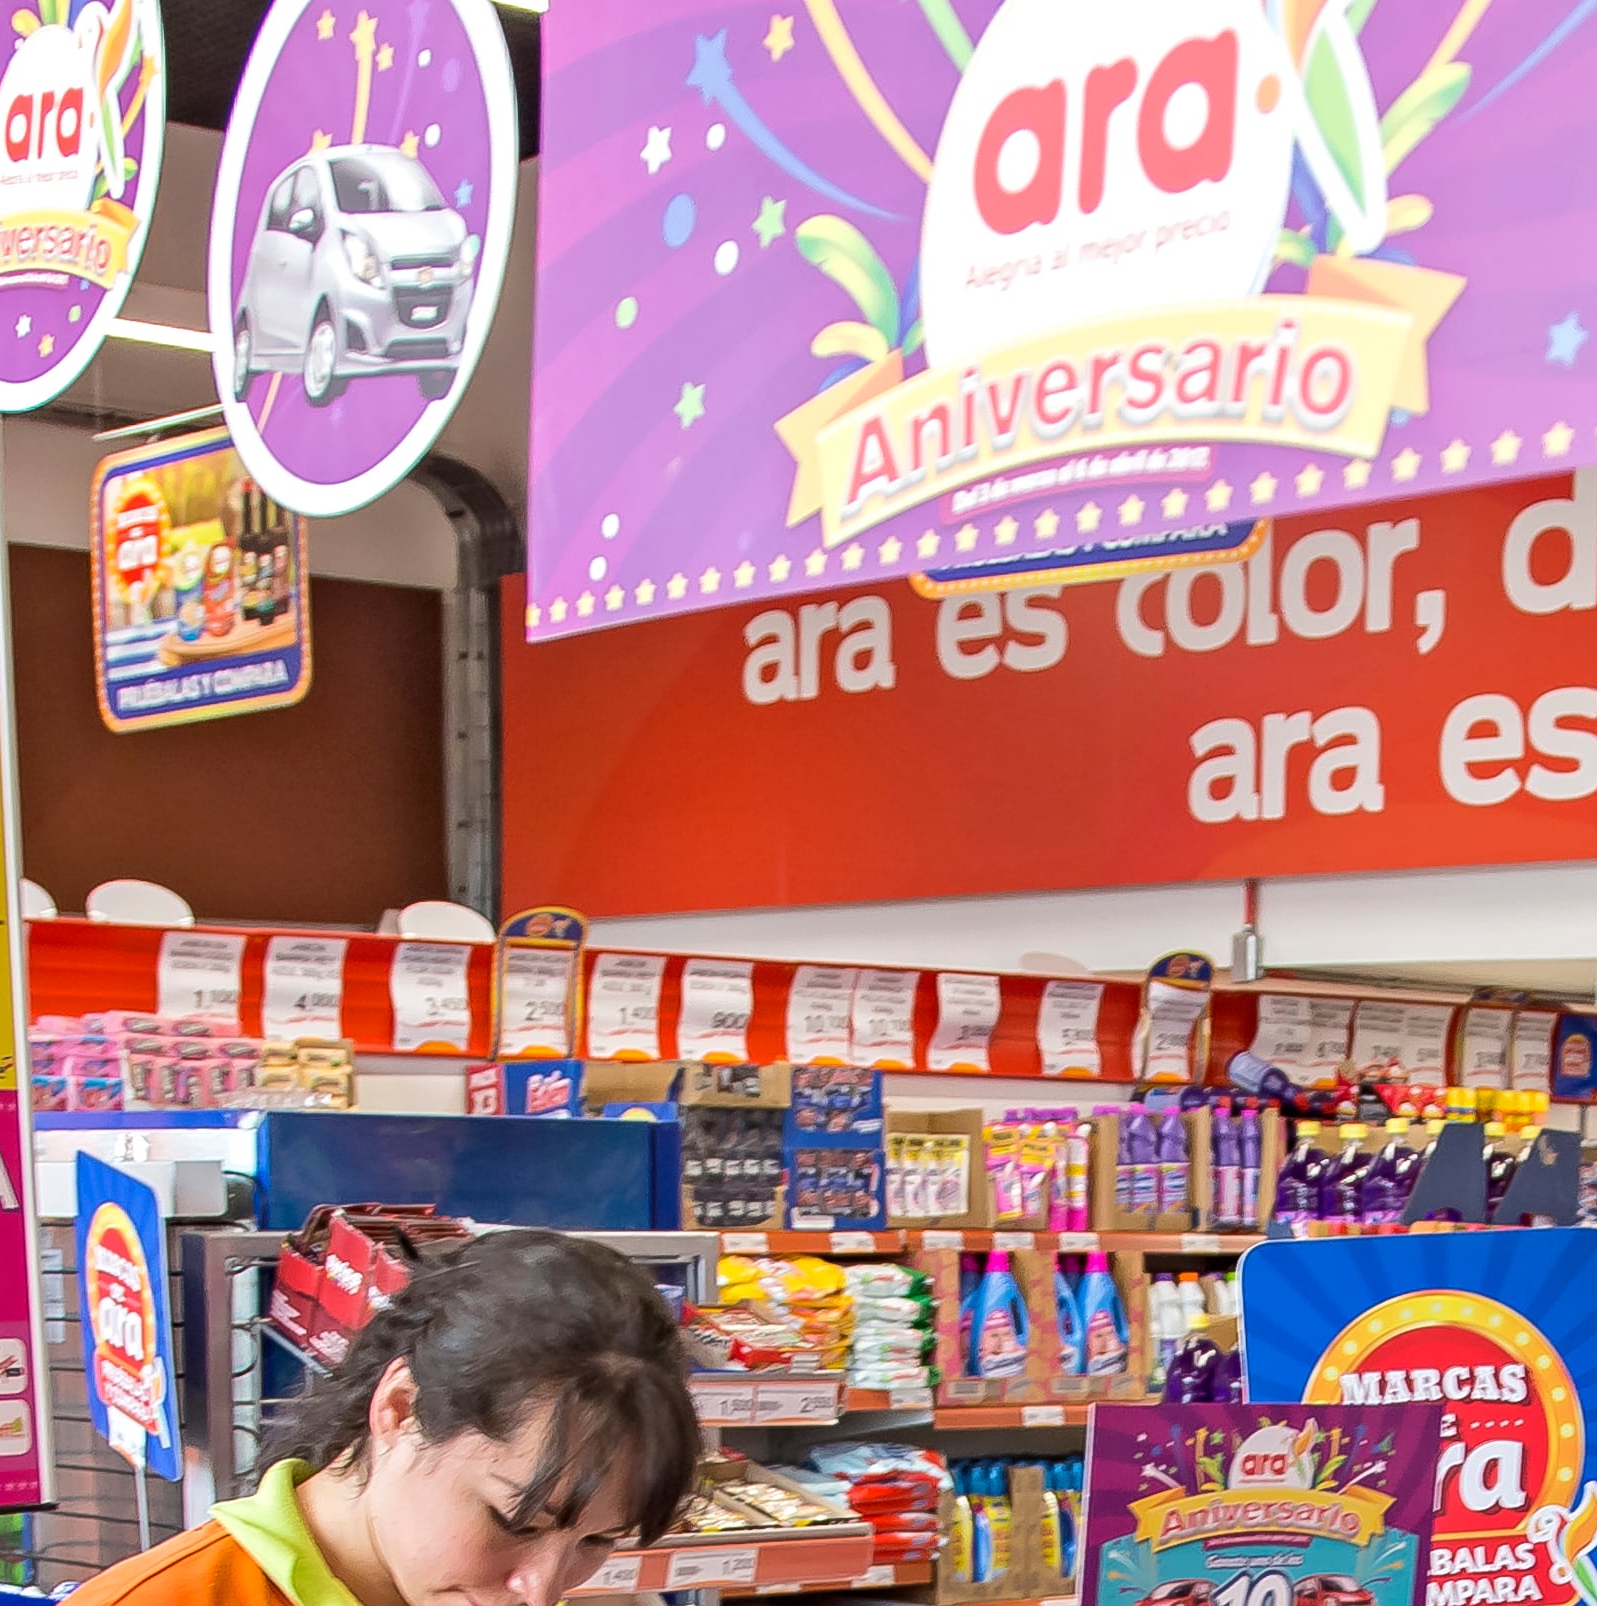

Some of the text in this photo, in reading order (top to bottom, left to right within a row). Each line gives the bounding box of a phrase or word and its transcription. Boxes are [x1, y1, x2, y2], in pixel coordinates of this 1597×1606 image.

[5, 87, 83, 163] ara
[973, 27, 1240, 235] ara
[842, 318, 1354, 520] Aniversario
[741, 595, 896, 707] ara
[935, 583, 1071, 682] es
[1115, 520, 1447, 658] color,
[1187, 706, 1386, 823] ara
[1339, 1363, 1529, 1407] MARCAS
[1439, 1413, 1458, 1438] E
[1241, 1452, 1288, 1479] ara
[1432, 1438, 1528, 1512] ra
[1159, 1497, 1361, 1539] Aniversario
[1429, 1541, 1537, 1578] BALAS
